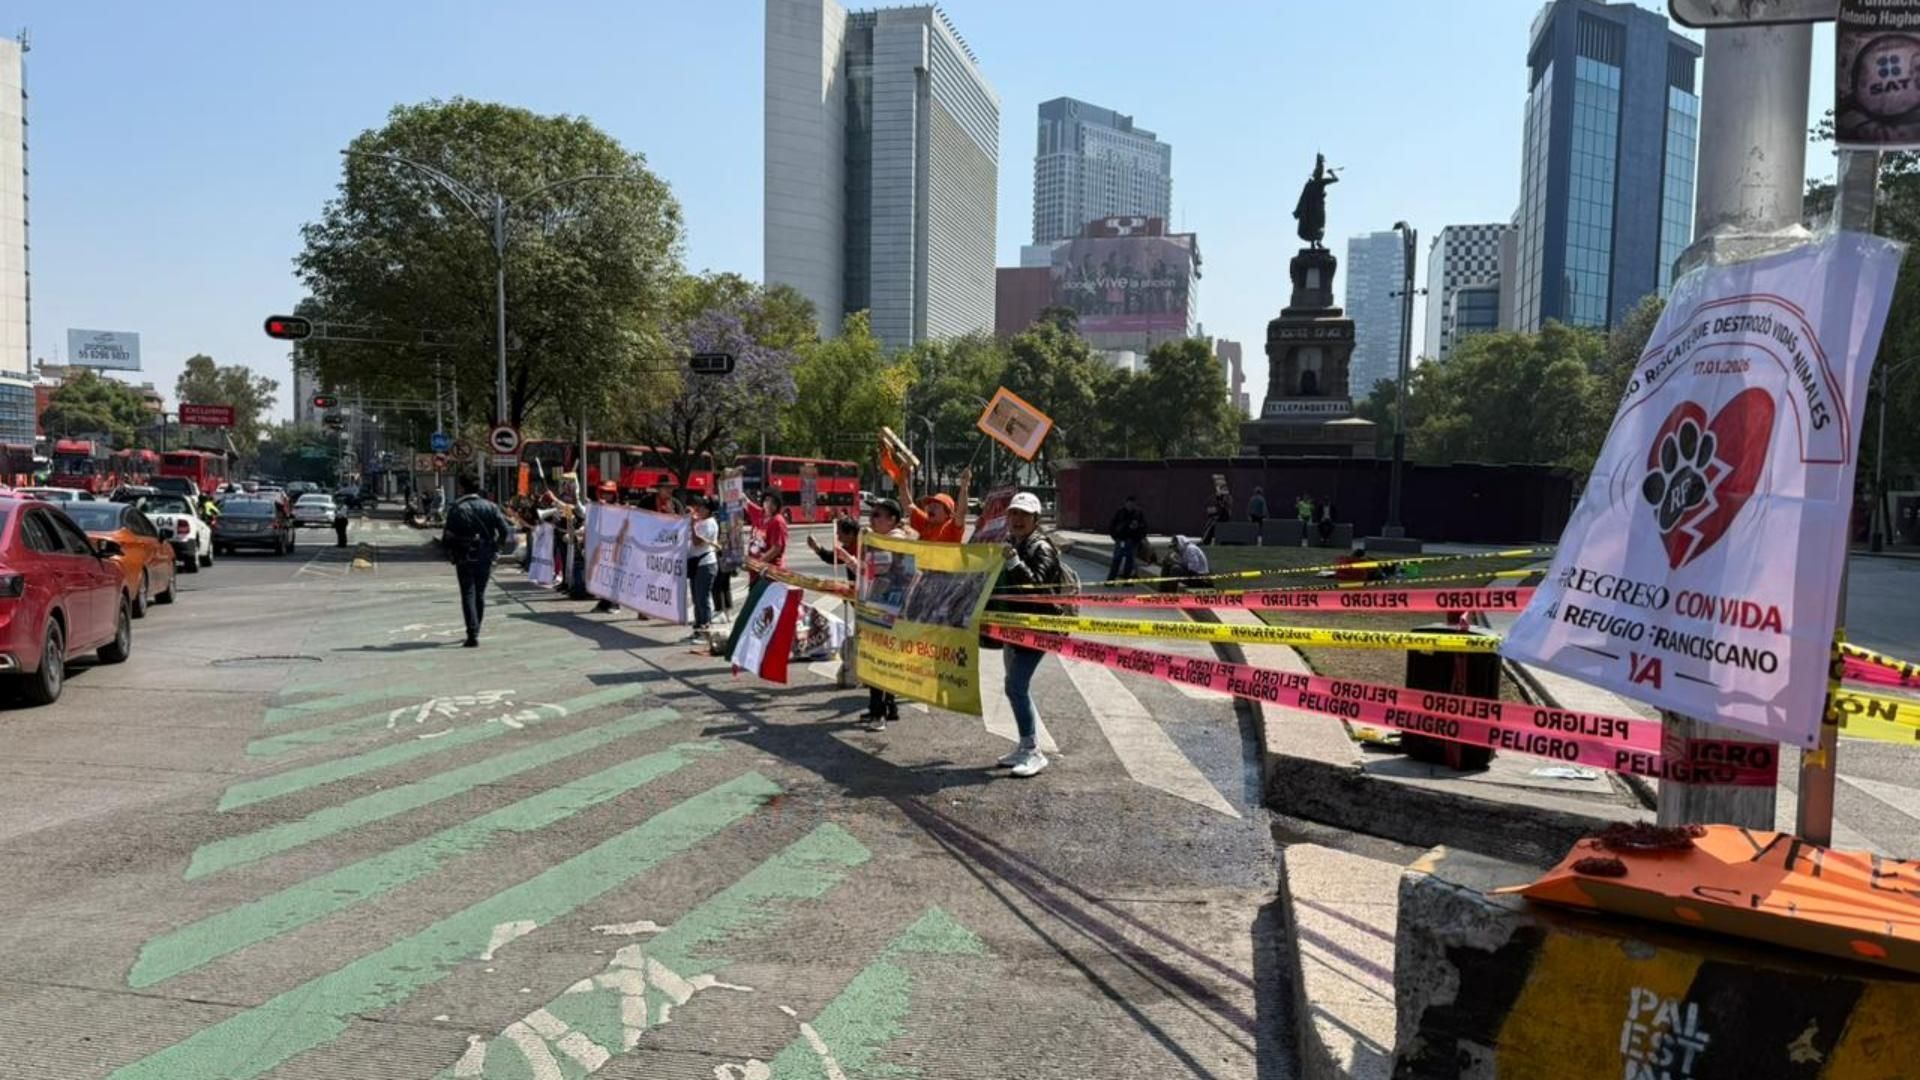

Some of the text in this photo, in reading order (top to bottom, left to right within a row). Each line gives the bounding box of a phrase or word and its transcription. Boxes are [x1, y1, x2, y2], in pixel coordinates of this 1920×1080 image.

[1869, 79, 1912, 95] SAT
[1096, 275, 1128, 289] vive
[1713, 313, 1773, 334] DESTROZÓ
[1771, 320, 1798, 353] VIDAS
[1670, 477, 1691, 513] RF
[1560, 565, 1783, 634] REGRESO CON VIDA
[1563, 605, 1644, 641] REFUGIO
[916, 641, 957, 665] BASURA
[1628, 652, 1663, 690] YA
[1117, 655, 1155, 675] PELIGRO
[1168, 665, 1212, 687] PELIGRO
[1227, 678, 1279, 702] PELIGRO
[1299, 692, 1360, 718] PELIGRO
[1385, 708, 1460, 738] PELIGRO
[1488, 727, 1580, 761] PELIGRO
[1615, 751, 1736, 783] PELIGRO
[1628, 987, 1711, 1042] PAL
[1621, 1020, 1705, 1075] EST
